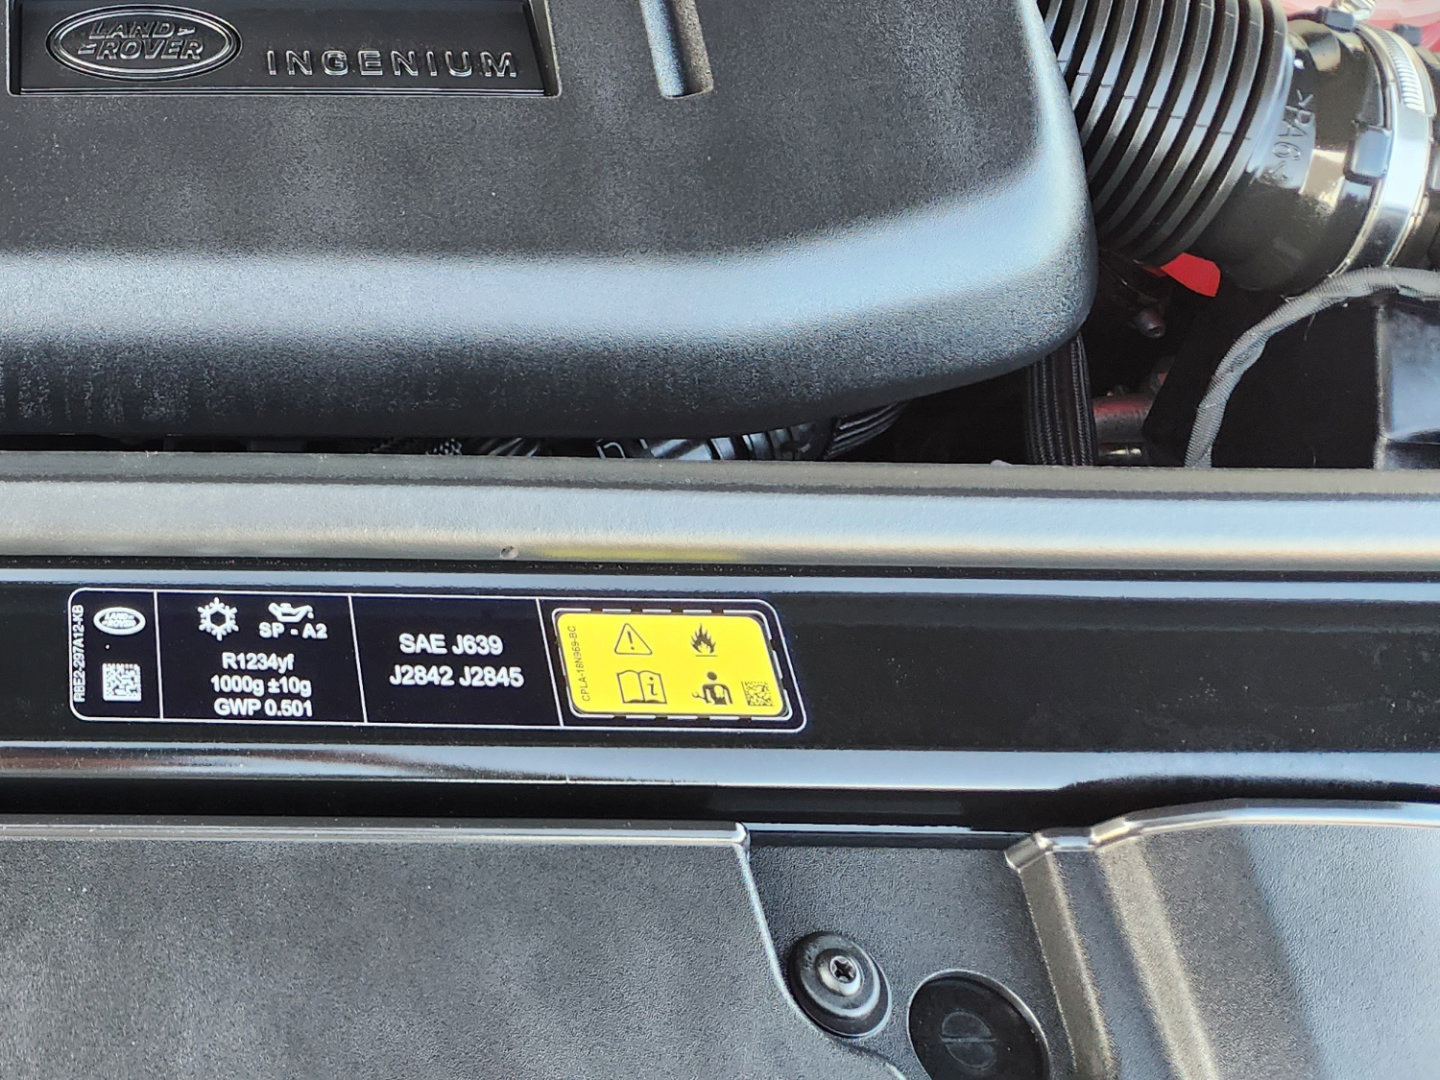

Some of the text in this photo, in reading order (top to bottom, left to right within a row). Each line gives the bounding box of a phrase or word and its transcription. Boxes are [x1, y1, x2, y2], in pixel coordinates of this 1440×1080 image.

[88, 19, 174, 39] LAND
[96, 38, 206, 61] ROVER
[265, 49, 519, 78] INGENIUM
[258, 622, 285, 639] SP
[302, 623, 328, 640] A2
[398, 633, 504, 656] SAE J639
[222, 652, 295, 674] R1234yf
[211, 676, 312, 698] 1000g ±10g
[388, 666, 525, 689] J2842 J2845
[213, 698, 313, 718] GWP 0.501
